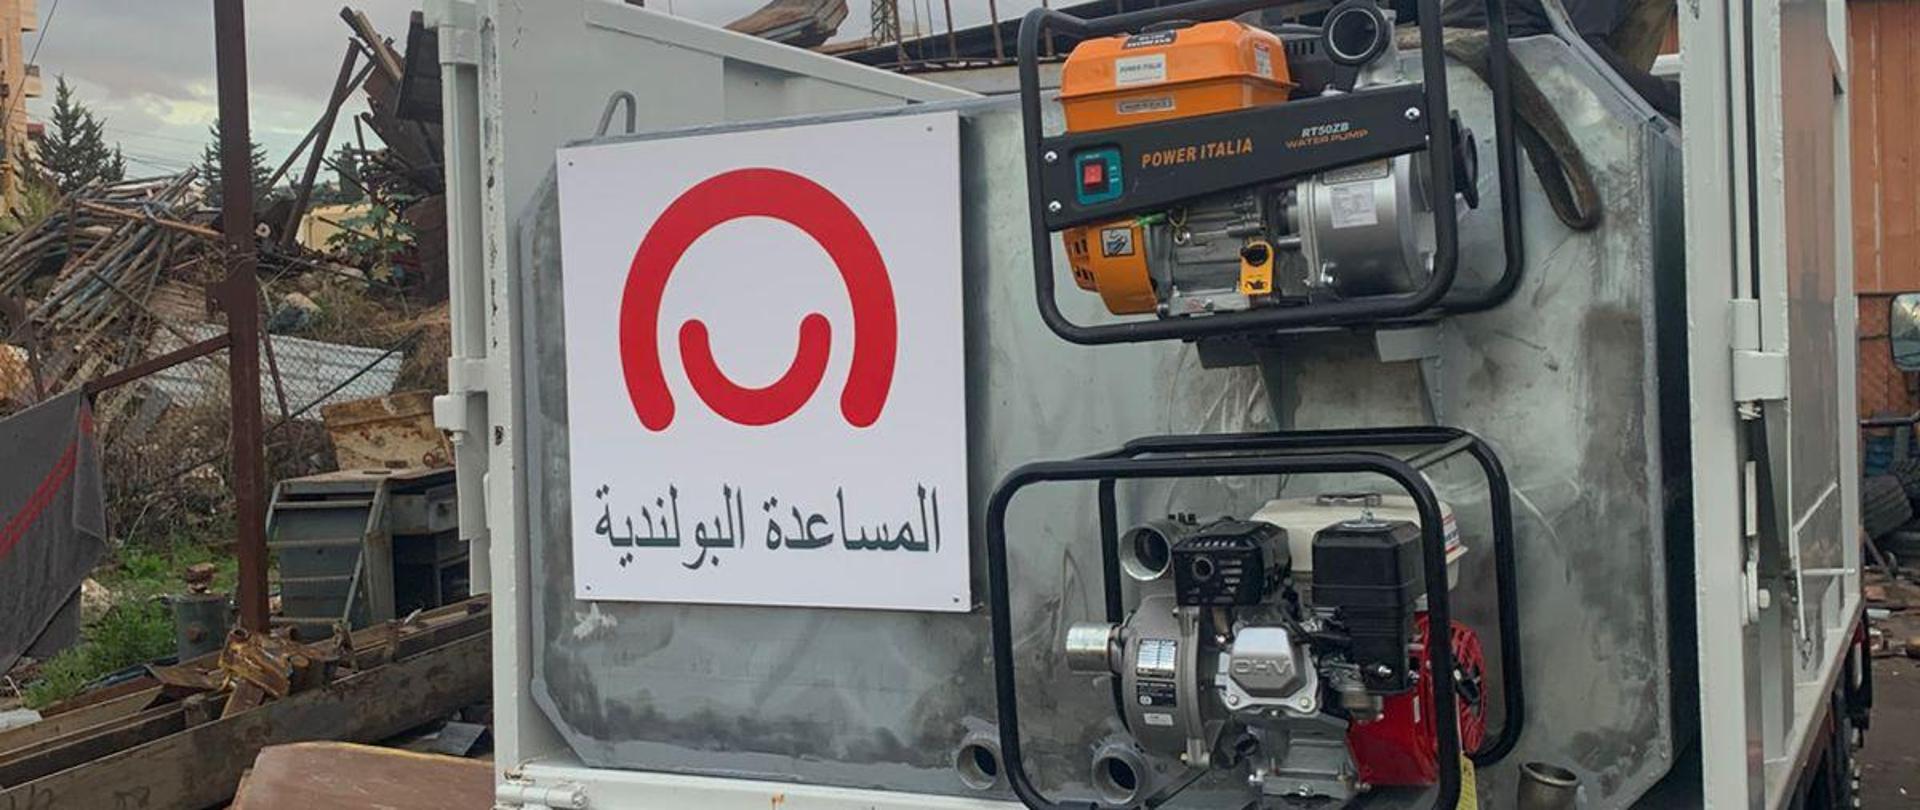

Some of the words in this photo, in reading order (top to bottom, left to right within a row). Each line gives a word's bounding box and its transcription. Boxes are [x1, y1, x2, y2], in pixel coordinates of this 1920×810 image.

[1284, 135, 1329, 150] WATER
[1330, 128, 1369, 141] PUMP
[1301, 122, 1350, 138] RT50ZB
[1141, 146, 1196, 169] POWER
[1200, 138, 1253, 159] ITALIA
[594, 483, 746, 571] البولندية
[763, 482, 940, 554] المساعدة
[1233, 658, 1292, 675] OHV
